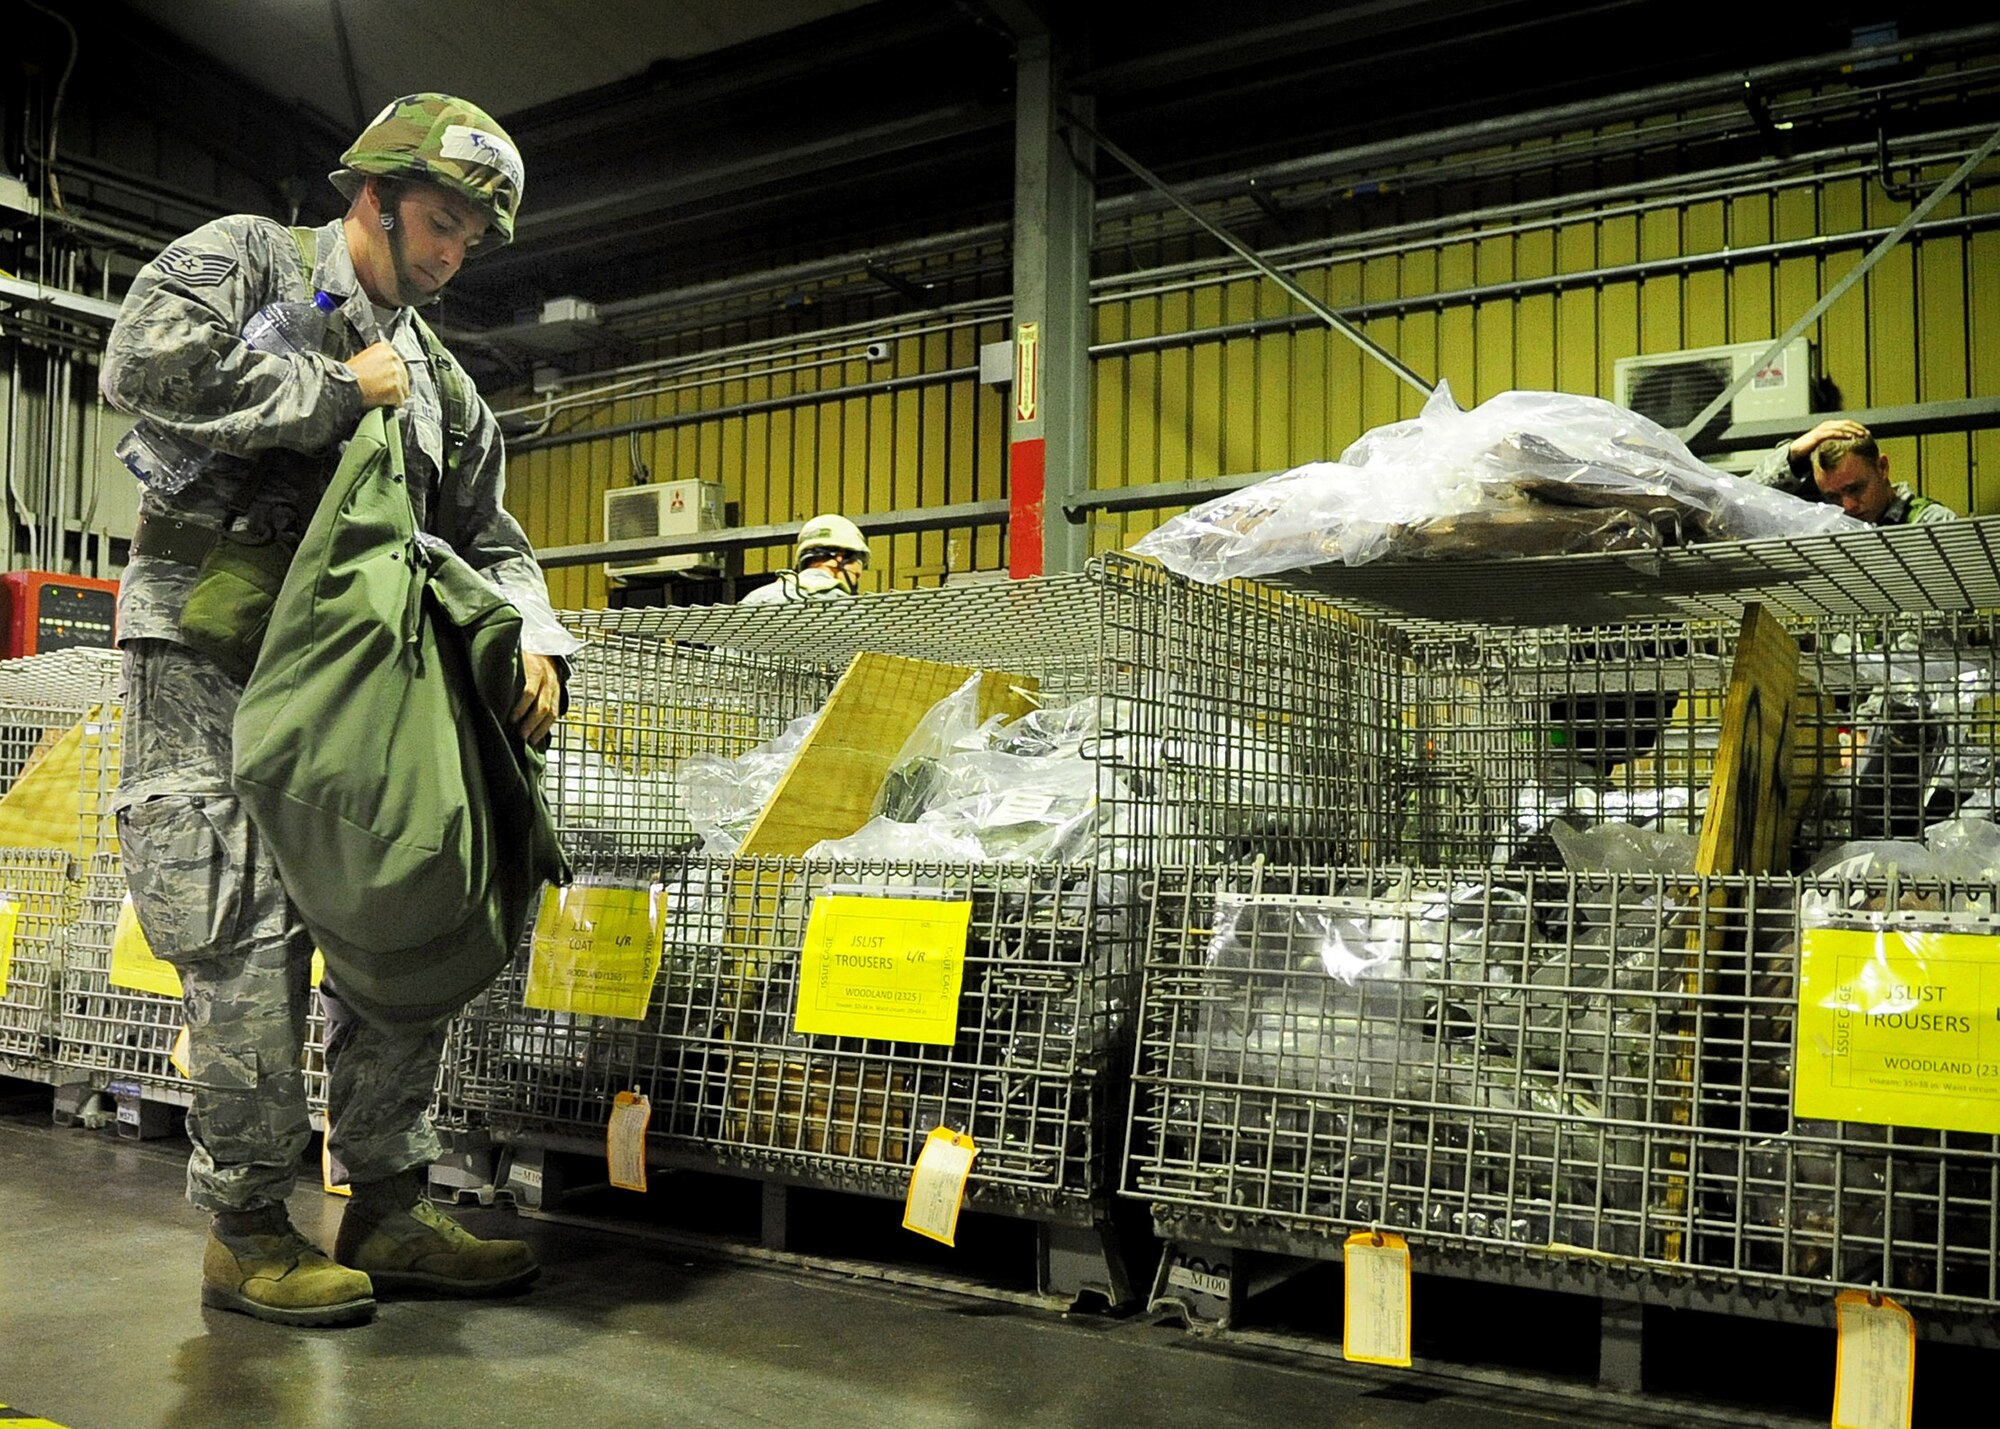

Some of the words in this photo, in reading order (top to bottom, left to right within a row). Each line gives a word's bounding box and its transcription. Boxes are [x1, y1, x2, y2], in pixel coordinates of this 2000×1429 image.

[568, 938, 594, 952] COAT
[615, 935, 632, 947] L/R
[850, 935, 885, 948] JSLIST
[835, 954, 893, 970] TROUSERS
[906, 949, 926, 963] L/R
[845, 988, 893, 1000] WOODLAND
[1885, 984, 1947, 1003] JSLIST
[1837, 1022, 1850, 1057] ISSUE
[1883, 1056, 1972, 1075] WOODLAND
[1191, 1272, 1226, 1292] M100
